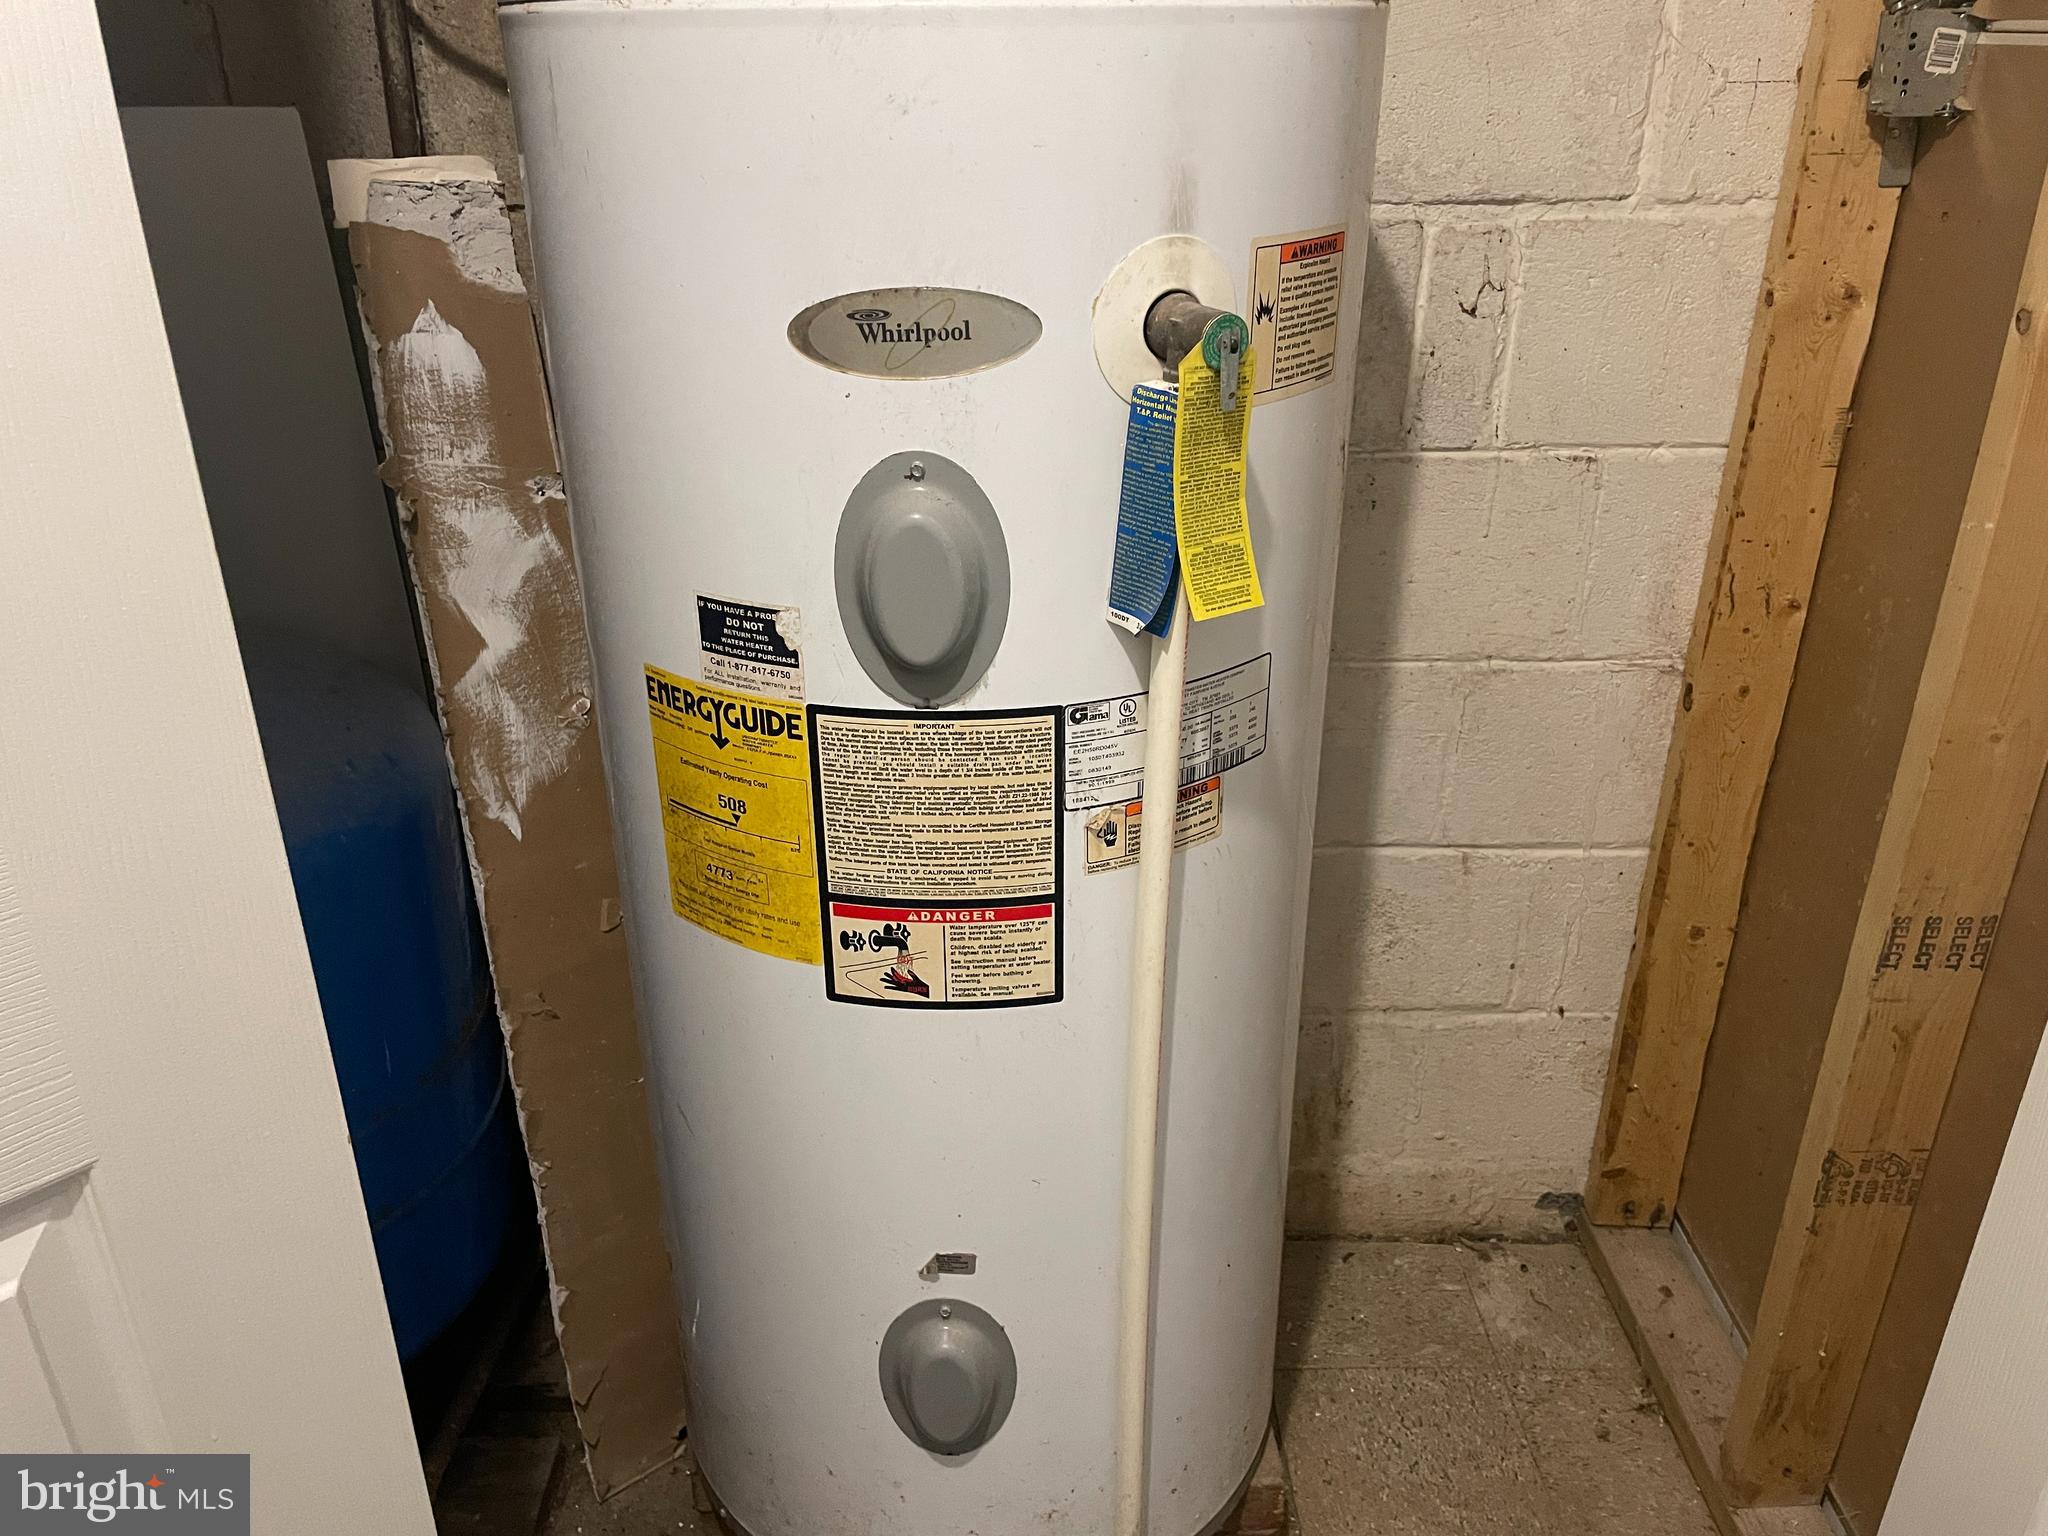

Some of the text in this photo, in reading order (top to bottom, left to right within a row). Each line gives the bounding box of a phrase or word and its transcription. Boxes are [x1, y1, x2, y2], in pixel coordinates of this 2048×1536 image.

[1299, 238, 1337, 257] WARNING
[856, 320, 972, 348] Whirlpool
[1132, 396, 1164, 409] Horizontal
[1137, 387, 1168, 401] Discharge
[1153, 411, 1172, 421] Relief
[707, 602, 722, 611] YOU
[724, 605, 745, 616] HAVE
[726, 617, 764, 631] DO NOT
[723, 628, 769, 642] RETURN THIS
[721, 637, 773, 652] WATER HEATER
[712, 643, 724, 651] THE
[725, 647, 746, 656] PLACE
[758, 653, 798, 665] PURCHASE.
[710, 657, 790, 679] Call 1-877-817-6750
[705, 675, 734, 686] performance
[761, 681, 786, 690] warranty
[645, 674, 803, 745] ENERGYGUIDE
[1123, 702, 1132, 714] UL
[1119, 716, 1136, 724] LISTED
[680, 757, 768, 789] Estimated Yearly Operating Cost
[1178, 784, 1209, 801] NING
[718, 793, 747, 815] 508
[706, 863, 734, 881] 4773
[920, 910, 996, 921] DANGER
[1880, 915, 1913, 972] SELECT
[1912, 915, 1943, 972] SELECT
[1944, 916, 1974, 972] SELECT
[1969, 914, 1999, 972] SELECT
